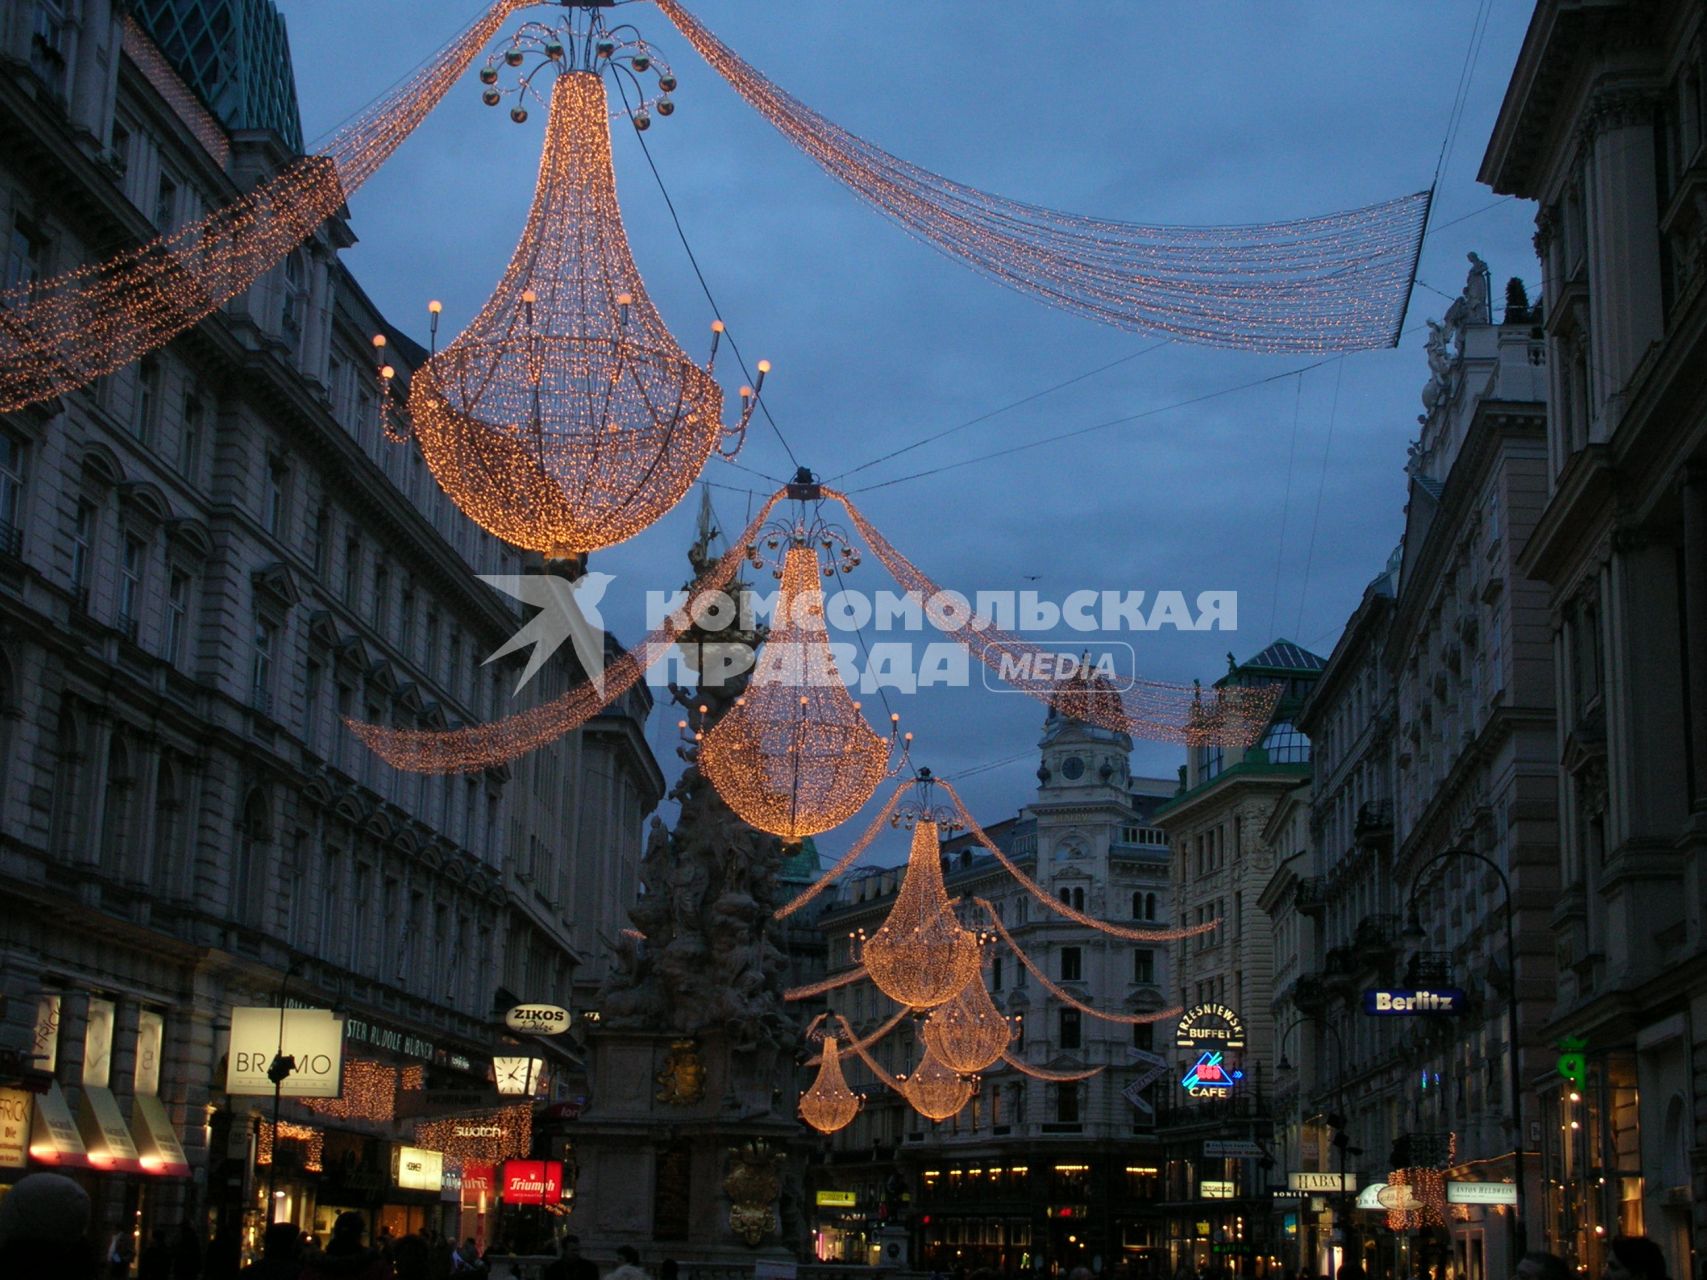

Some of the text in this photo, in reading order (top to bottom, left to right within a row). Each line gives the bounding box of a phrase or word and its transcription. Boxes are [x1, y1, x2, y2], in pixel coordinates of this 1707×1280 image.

[1376, 991, 1453, 1010] Berlitz
[514, 1009, 564, 1021] ZIKOS
[1176, 1003, 1245, 1038] TRZESNIEWSKI
[369, 1025, 402, 1051] RUDOLF
[1189, 1028, 1232, 1038] BUFFET
[236, 1052, 332, 1075] BRMO
[1189, 1087, 1227, 1098] CAFE
[454, 1124, 501, 1138] swatch
[509, 1177, 555, 1194] Triumph
